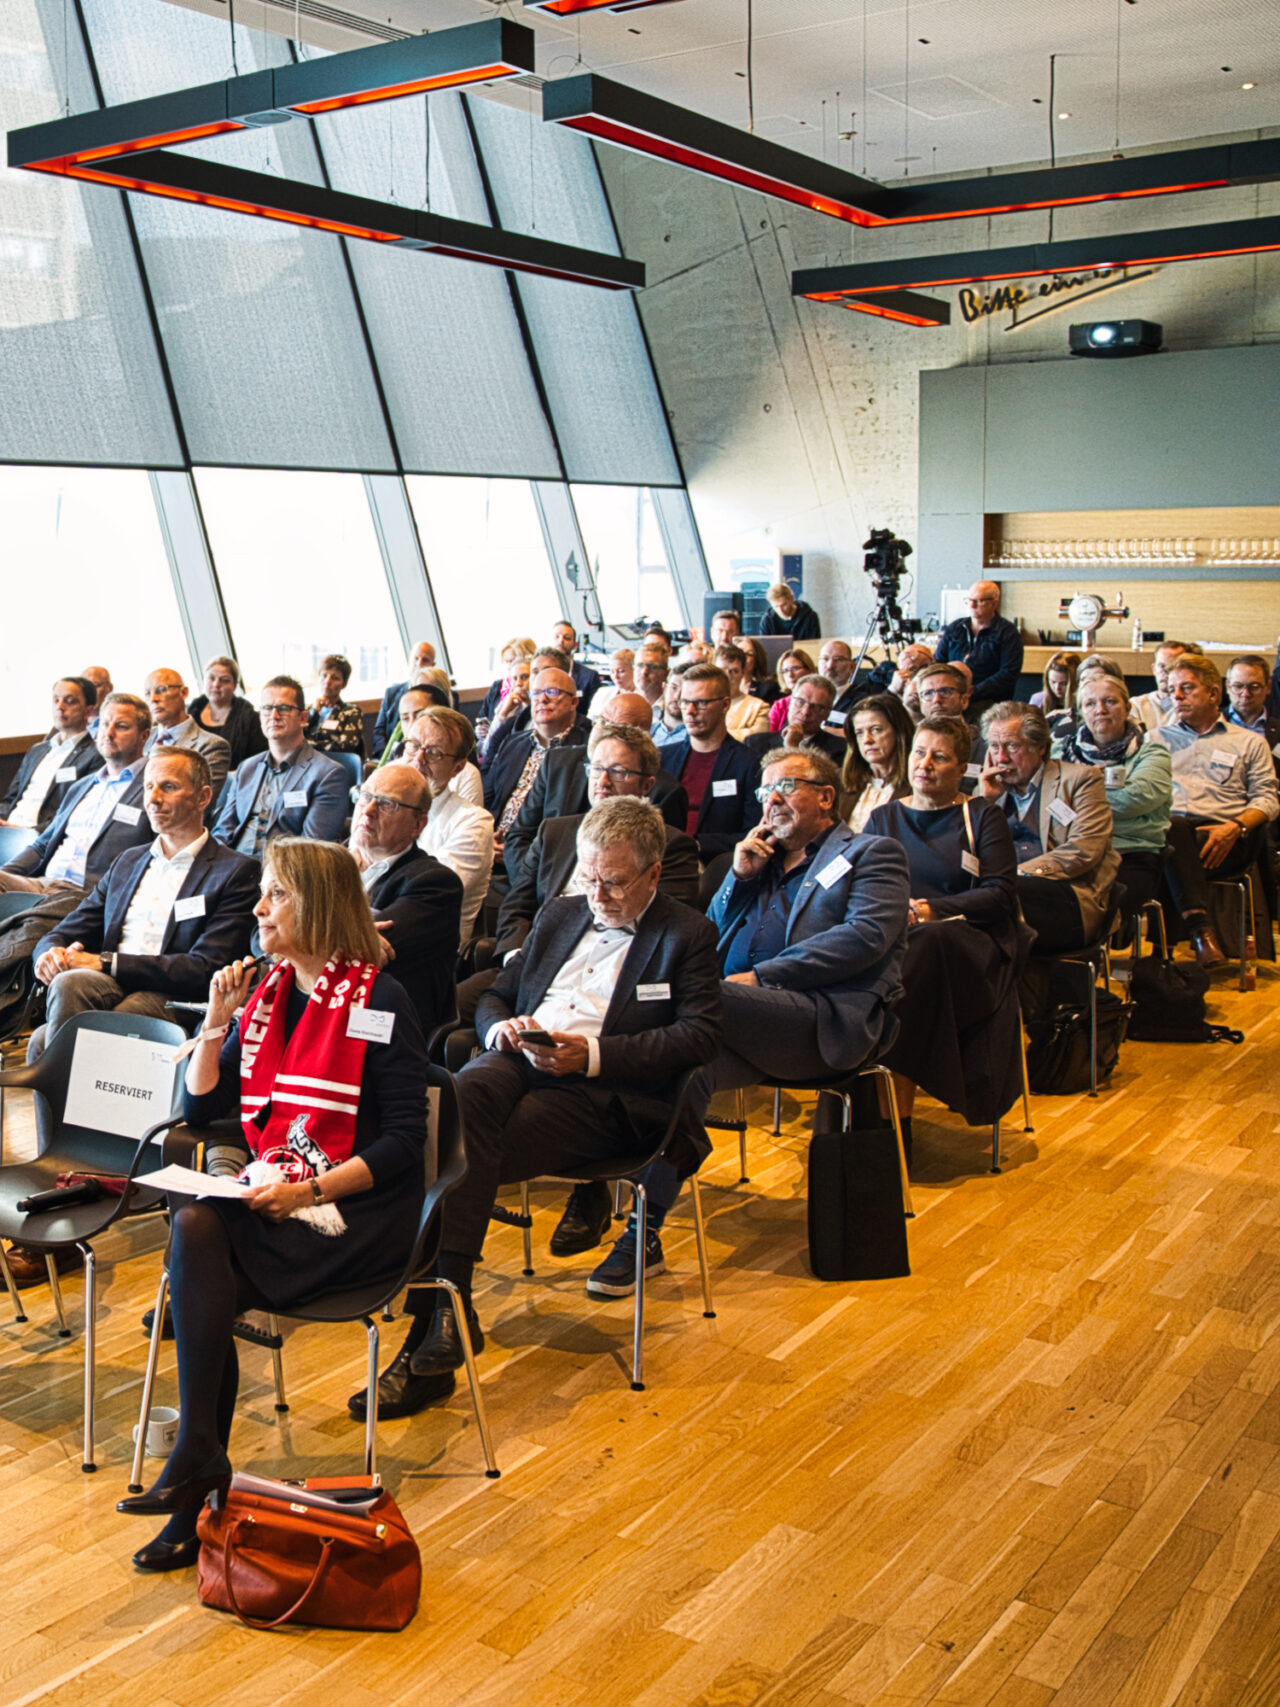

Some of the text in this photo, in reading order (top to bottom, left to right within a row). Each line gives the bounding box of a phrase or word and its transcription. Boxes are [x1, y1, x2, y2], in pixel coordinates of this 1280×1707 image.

[959, 273, 1084, 322] Bitte ein
[95, 1080, 153, 1101] RESERVIERT
